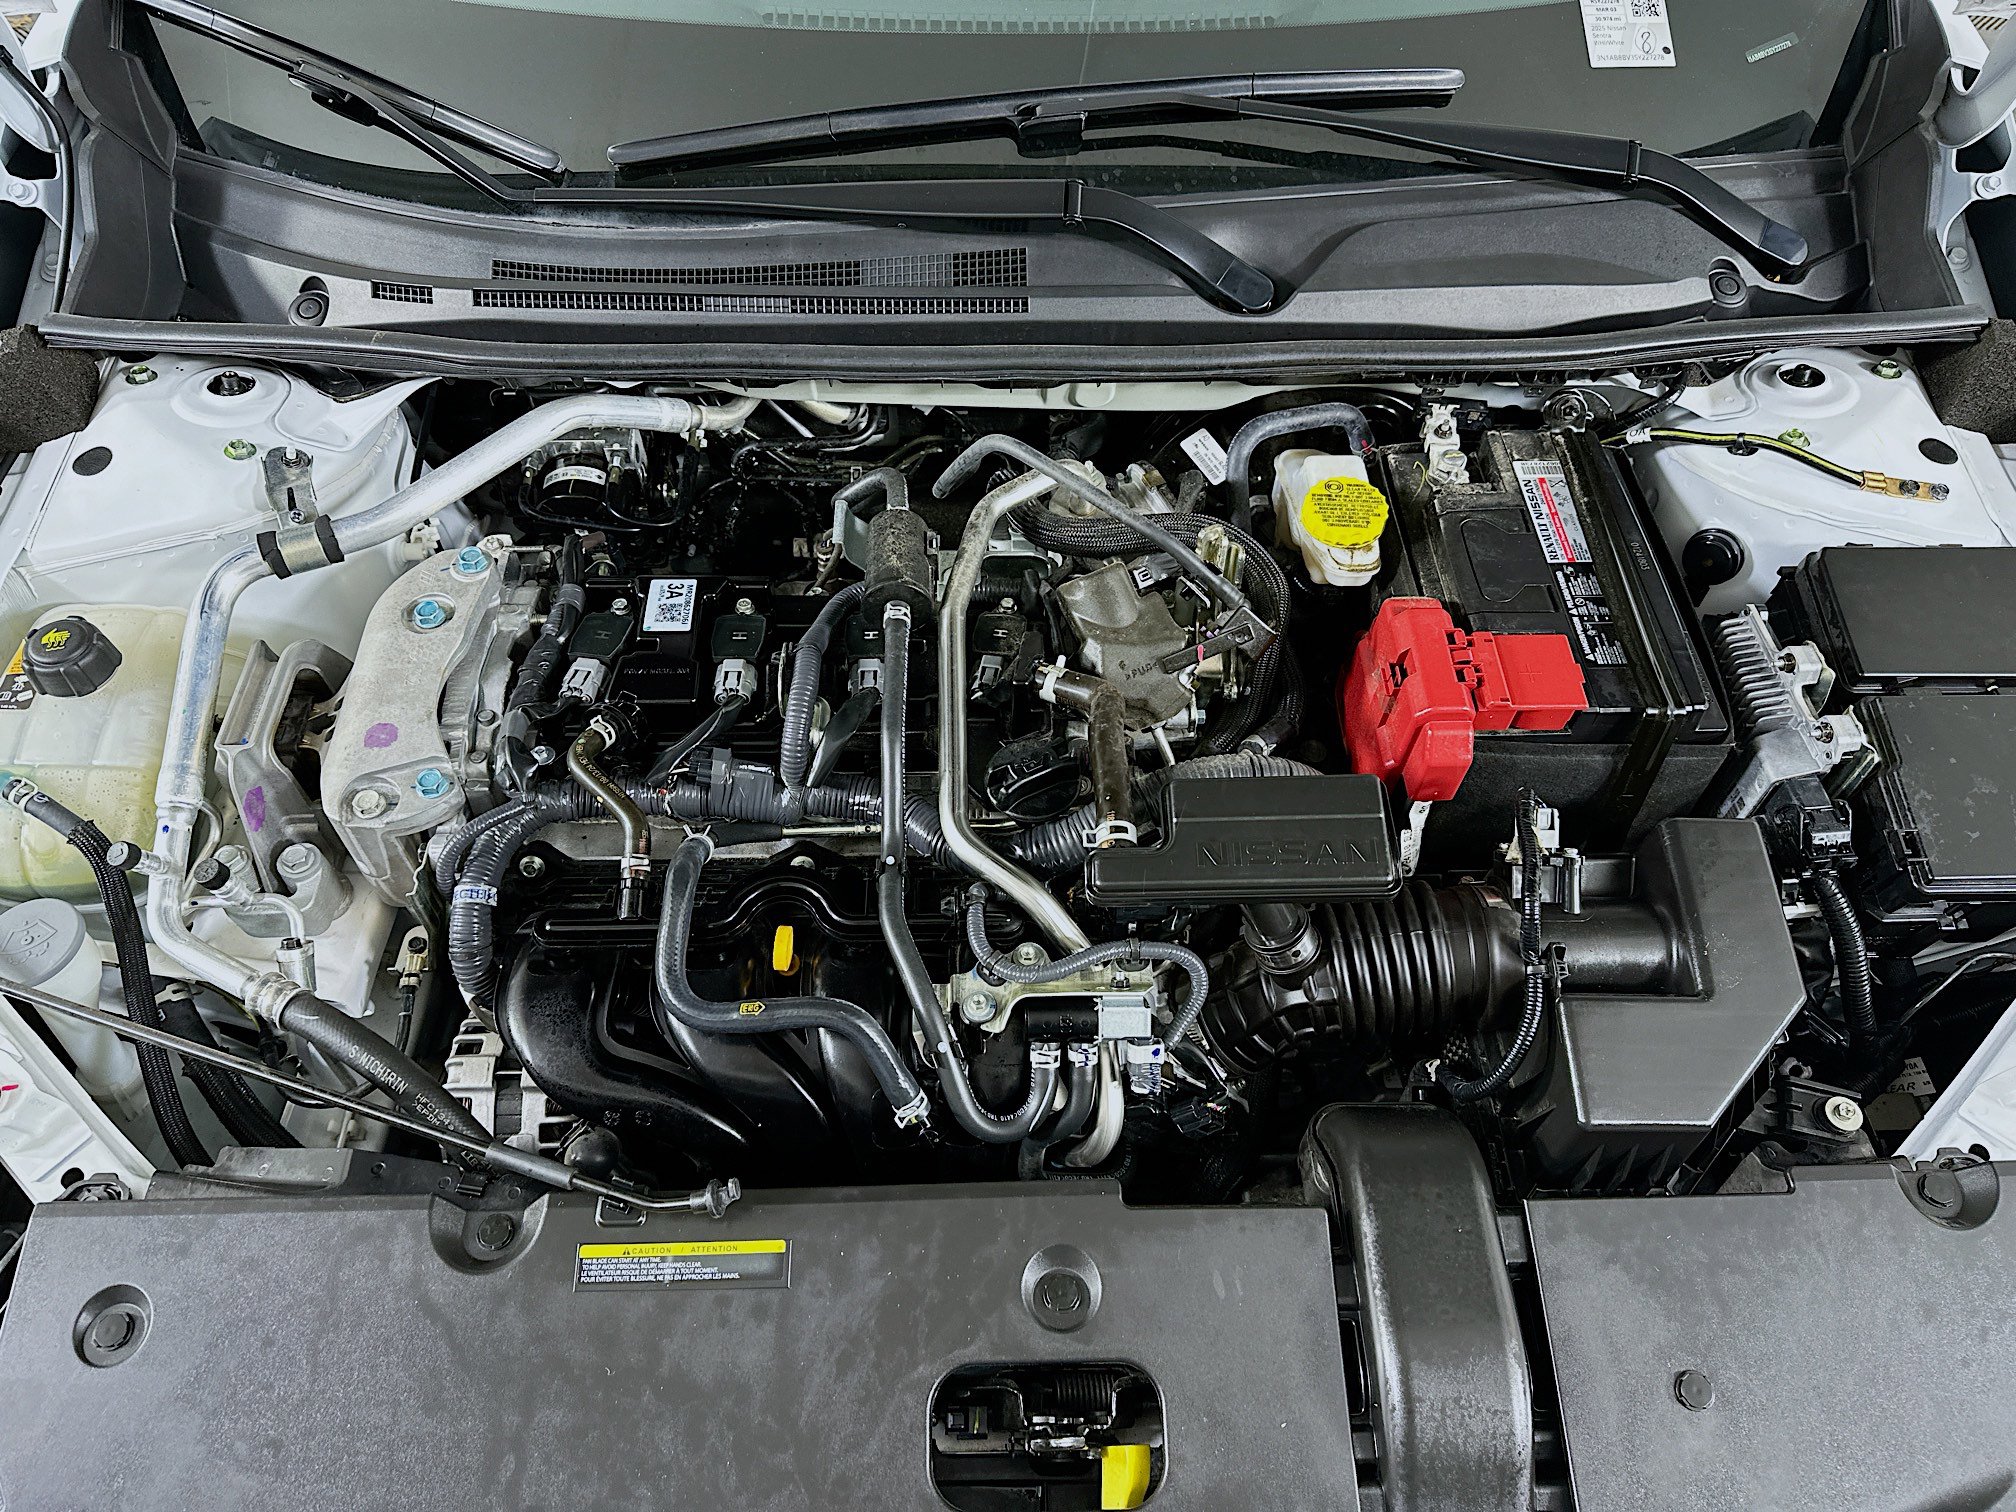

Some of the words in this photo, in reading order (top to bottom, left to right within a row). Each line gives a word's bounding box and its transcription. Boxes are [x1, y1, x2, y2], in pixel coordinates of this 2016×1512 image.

[1522, 480, 1544, 520] NISSAN
[1538, 523, 1560, 560] RENAULT
[666, 584, 684, 600] 3A
[1196, 840, 1380, 867] NISSAN
[742, 1004, 759, 1013] ENG
[632, 1247, 672, 1255] CAUTION
